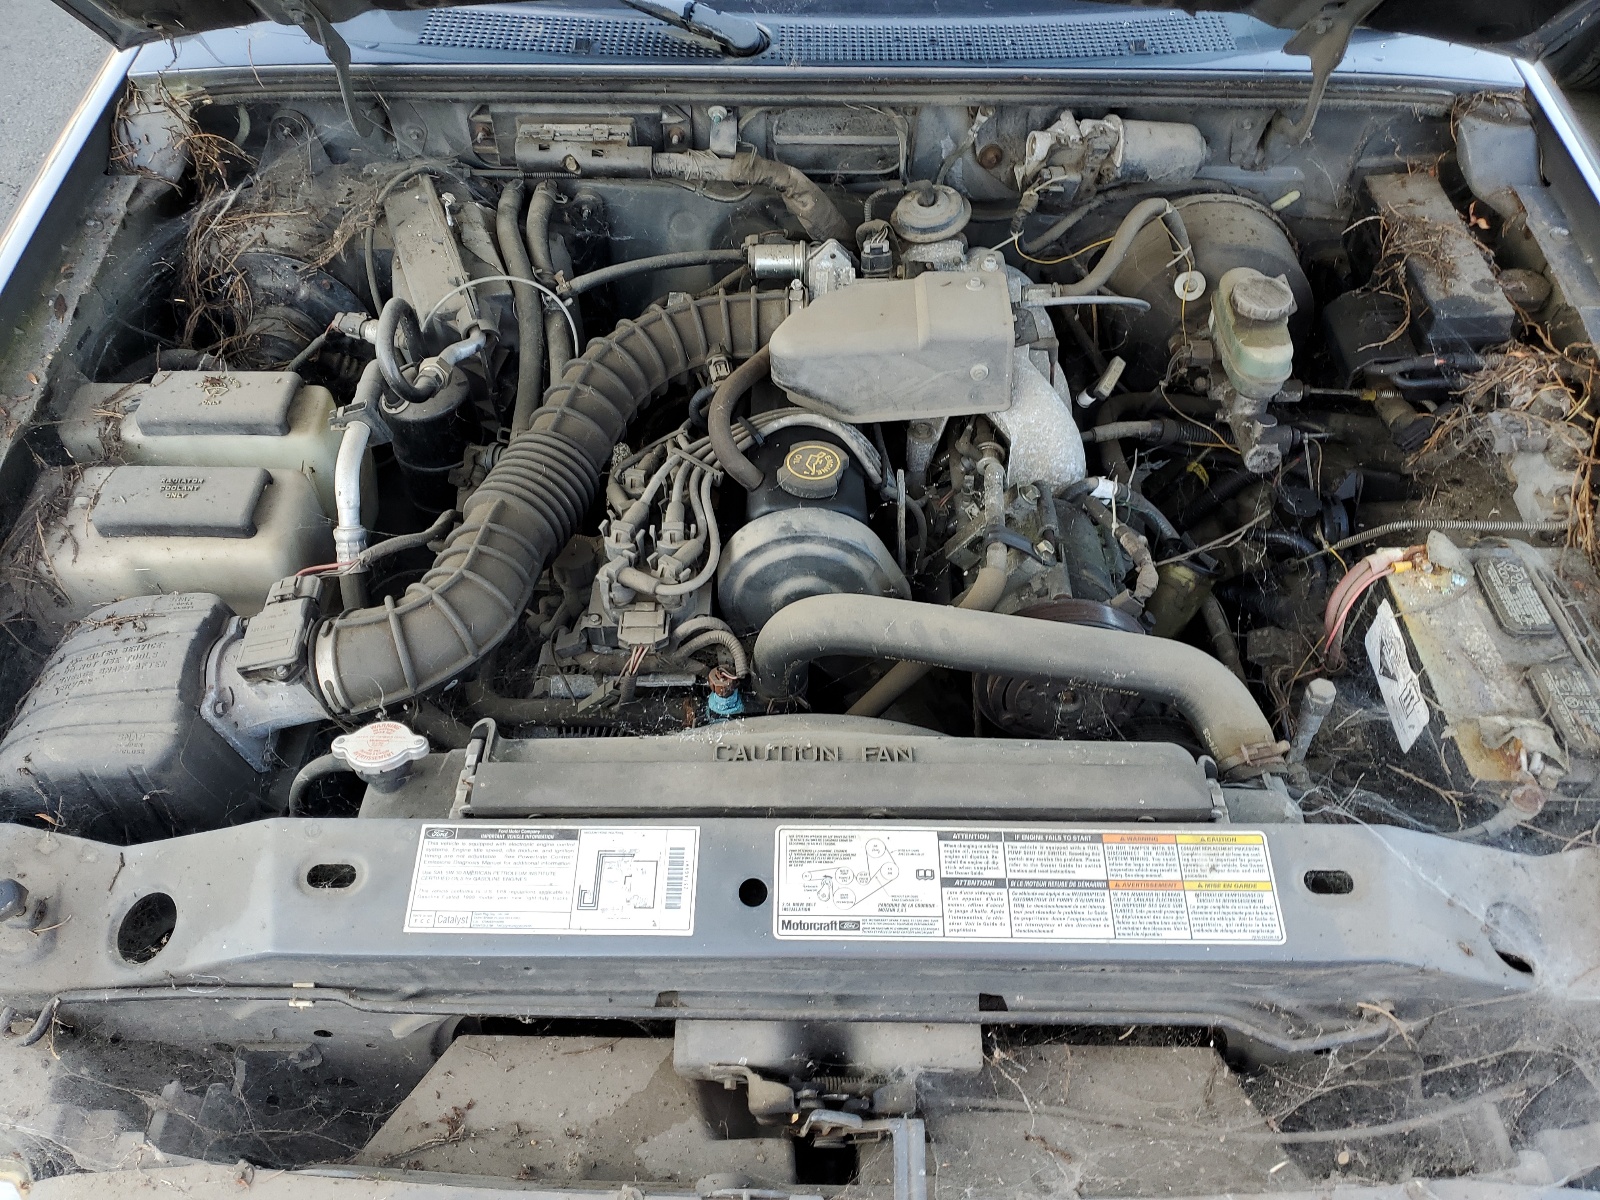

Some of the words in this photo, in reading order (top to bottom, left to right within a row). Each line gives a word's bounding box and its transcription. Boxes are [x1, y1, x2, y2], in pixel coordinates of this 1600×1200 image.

[792, 454, 802, 465] OIL
[816, 455, 834, 476] ENGINE
[102, 656, 122, 665] USE
[126, 652, 159, 662] TOOLS
[136, 660, 168, 670] AFTER
[712, 746, 840, 762] CAUTION
[860, 746, 915, 762] FAN
[430, 829, 450, 838] Ford
[437, 914, 469, 926] Catalyst
[781, 920, 838, 931] Motorcraft
